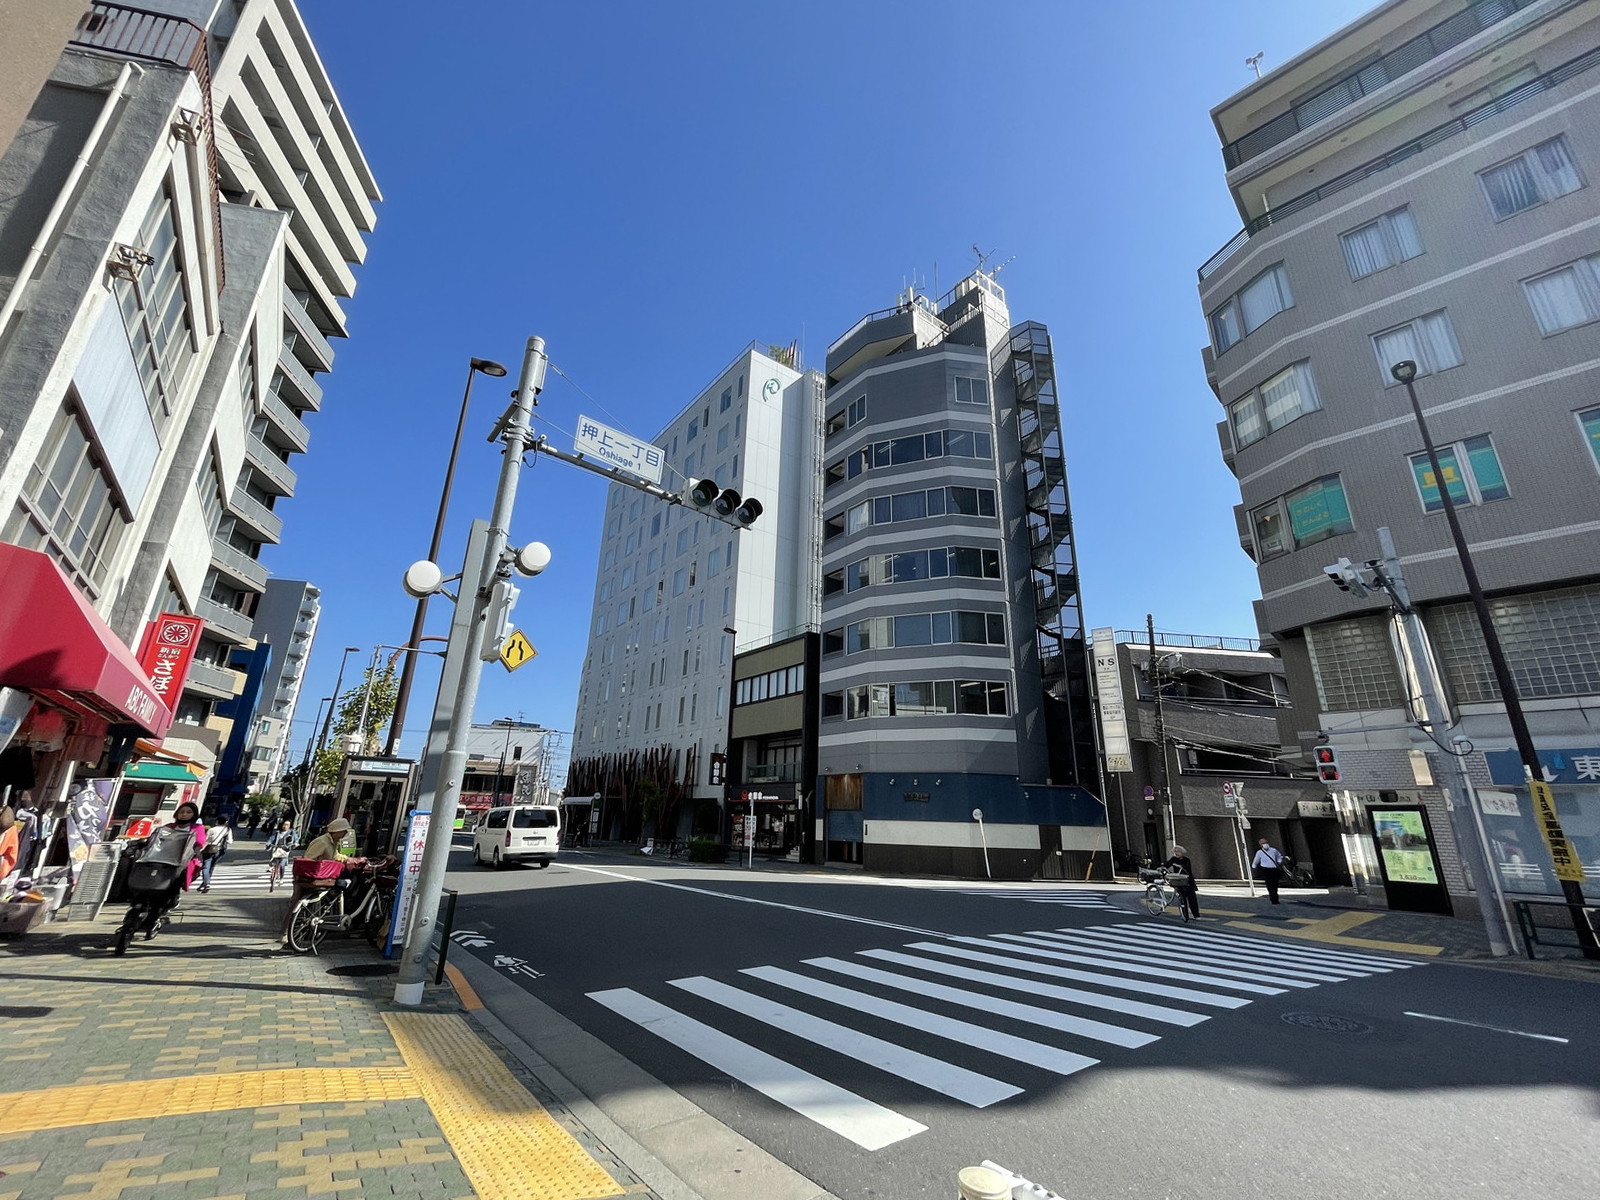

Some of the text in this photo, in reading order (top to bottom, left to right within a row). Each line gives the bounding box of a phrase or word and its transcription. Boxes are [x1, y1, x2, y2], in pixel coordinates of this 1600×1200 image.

[581, 423, 660, 467] 押上一丁目
[598, 446, 642, 471] Oshiage 1
[151, 658, 177, 695] さぼ
[408, 840, 425, 876] 休工中
